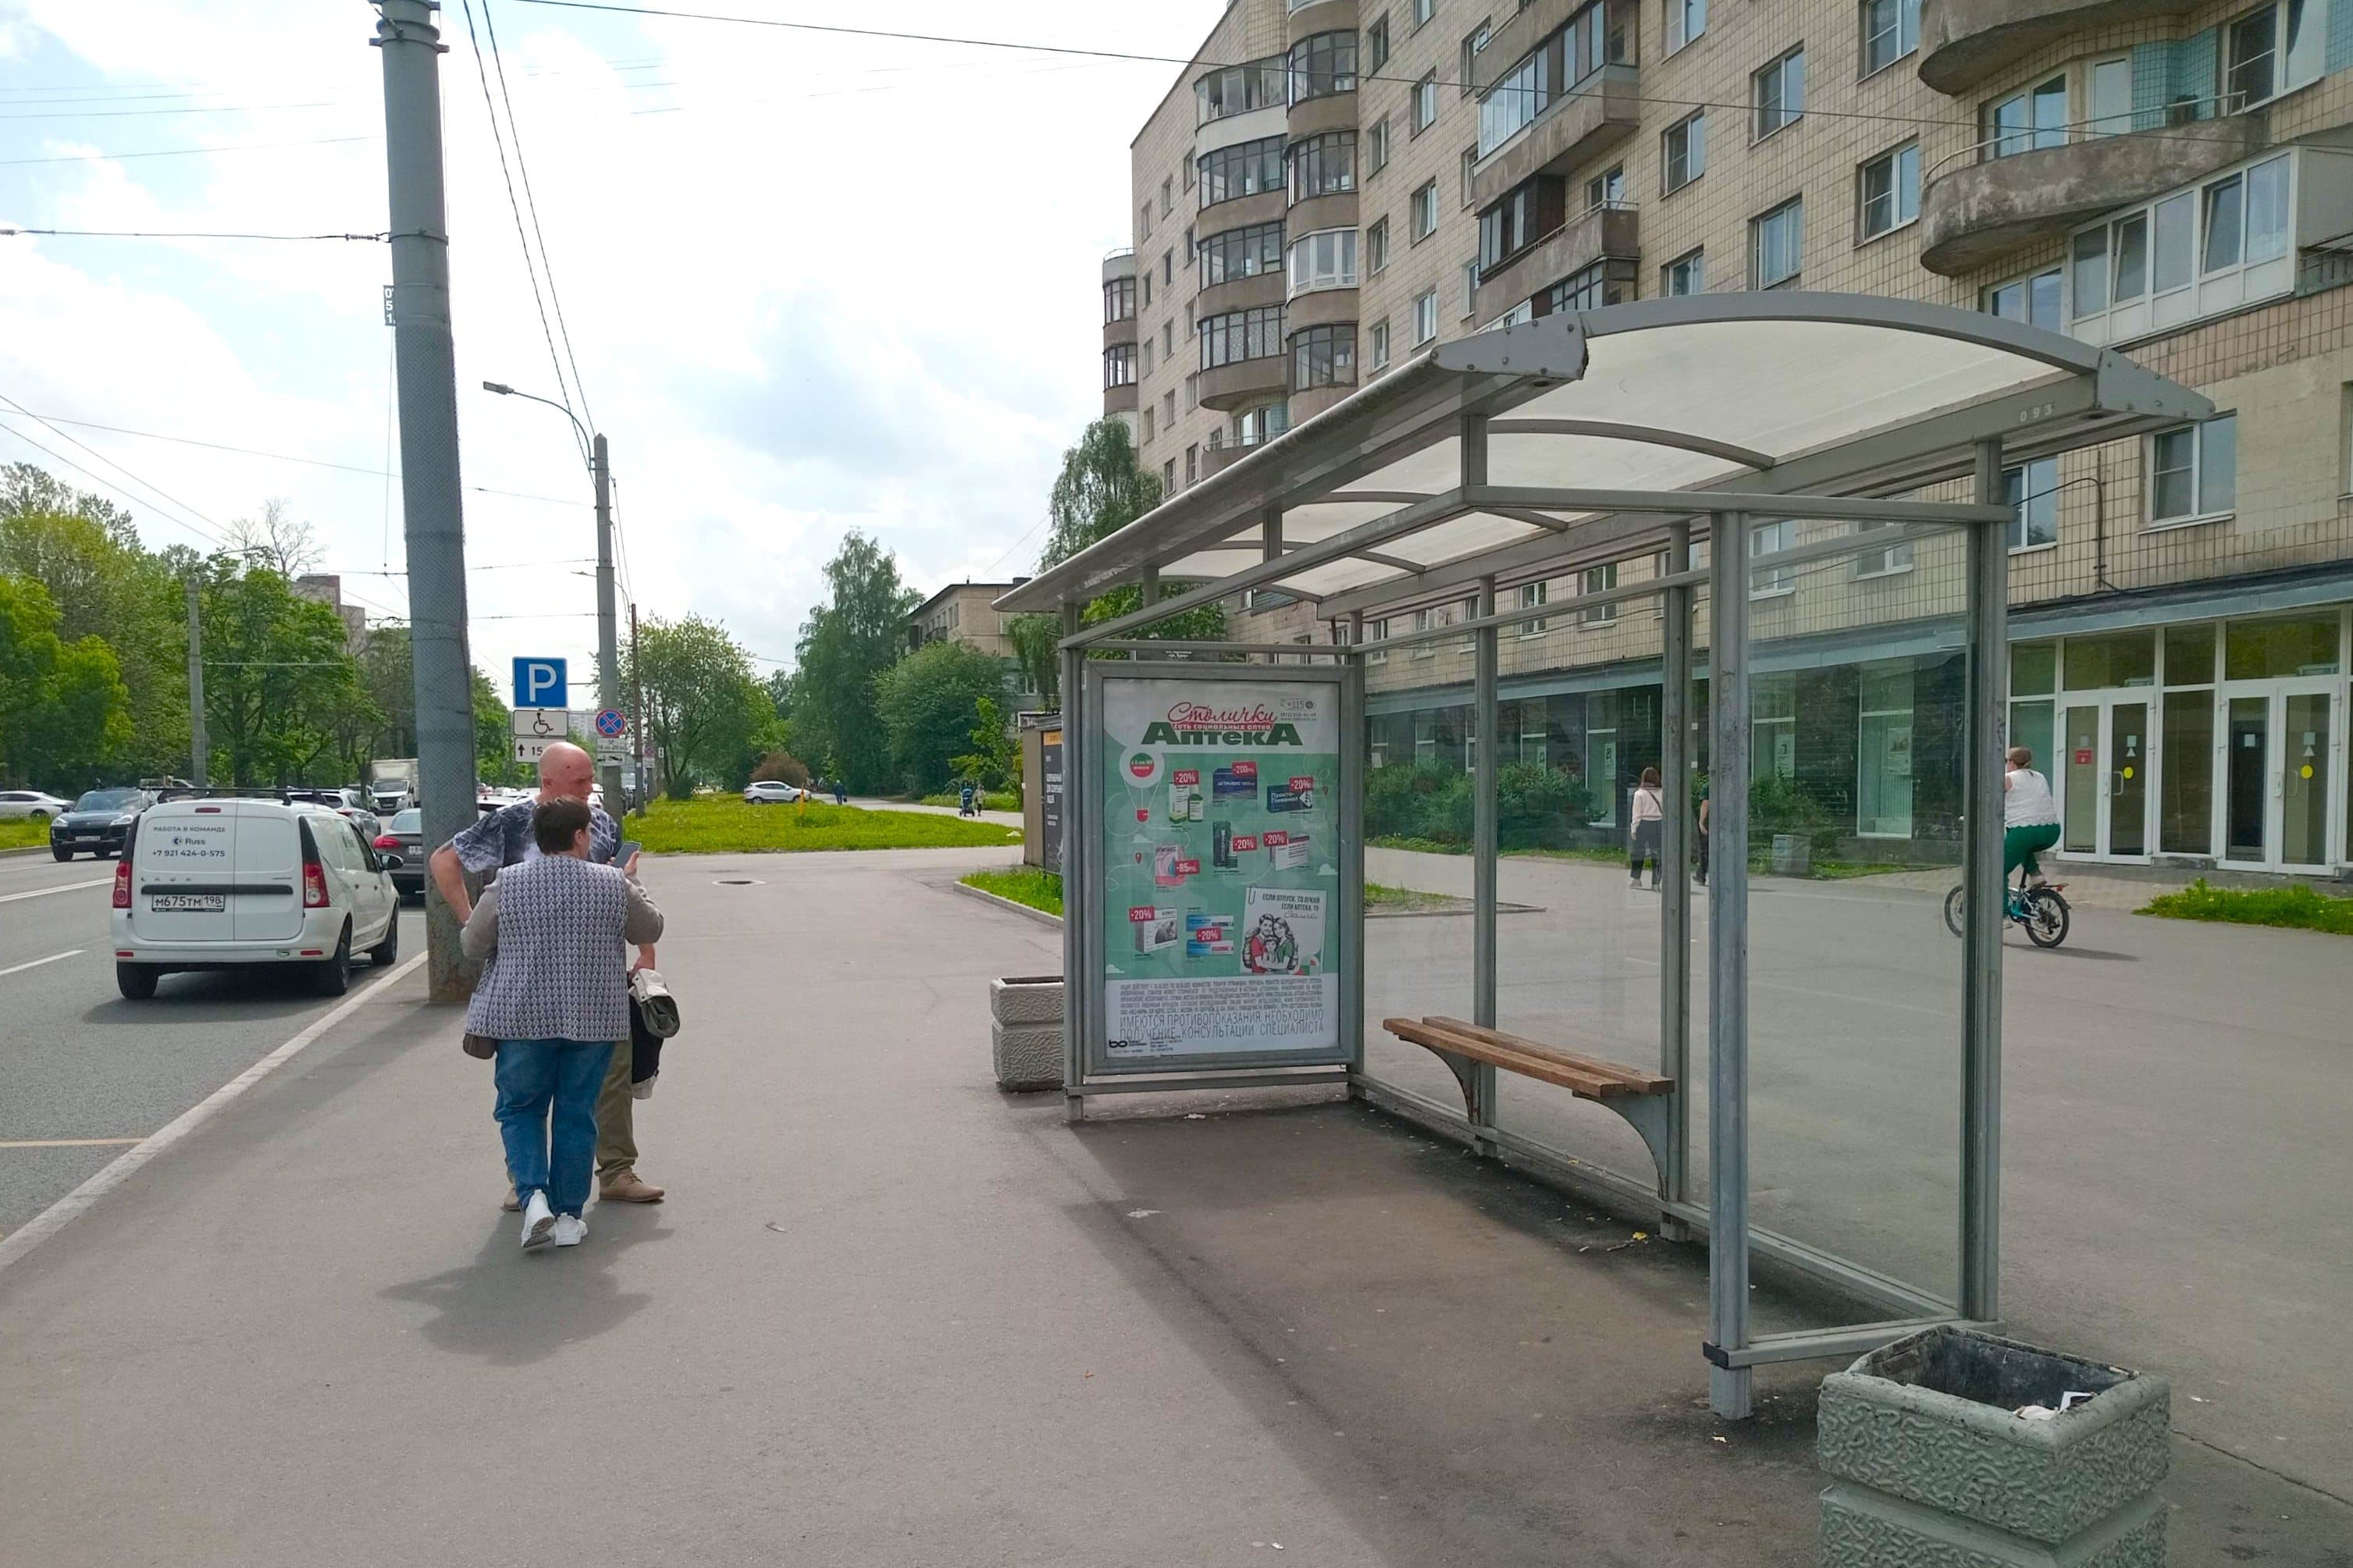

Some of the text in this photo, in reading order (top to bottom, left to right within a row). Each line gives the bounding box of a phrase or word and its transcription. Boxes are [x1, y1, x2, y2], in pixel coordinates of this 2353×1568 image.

[2020, 404, 2052, 421] 093
[529, 664, 557, 702] P
[1167, 702, 1277, 723] Столички
[1176, 772, 1197, 784] -20%
[1290, 780, 1312, 790] -20%
[1234, 838, 1254, 849] -20%
[1265, 834, 1284, 844] -20%
[1131, 909, 1152, 919] -20%
[1198, 930, 1219, 940] -20%
[1120, 1014, 1165, 1028] ИМЕЮТСЯ
[1265, 1009, 1324, 1022] НЕОБХОДИМО
[1120, 1021, 1324, 1041] ПОЛУЧЕНИЕ КОНСУЛЬТАЦИИ СПЕЦИАЛИСТА
